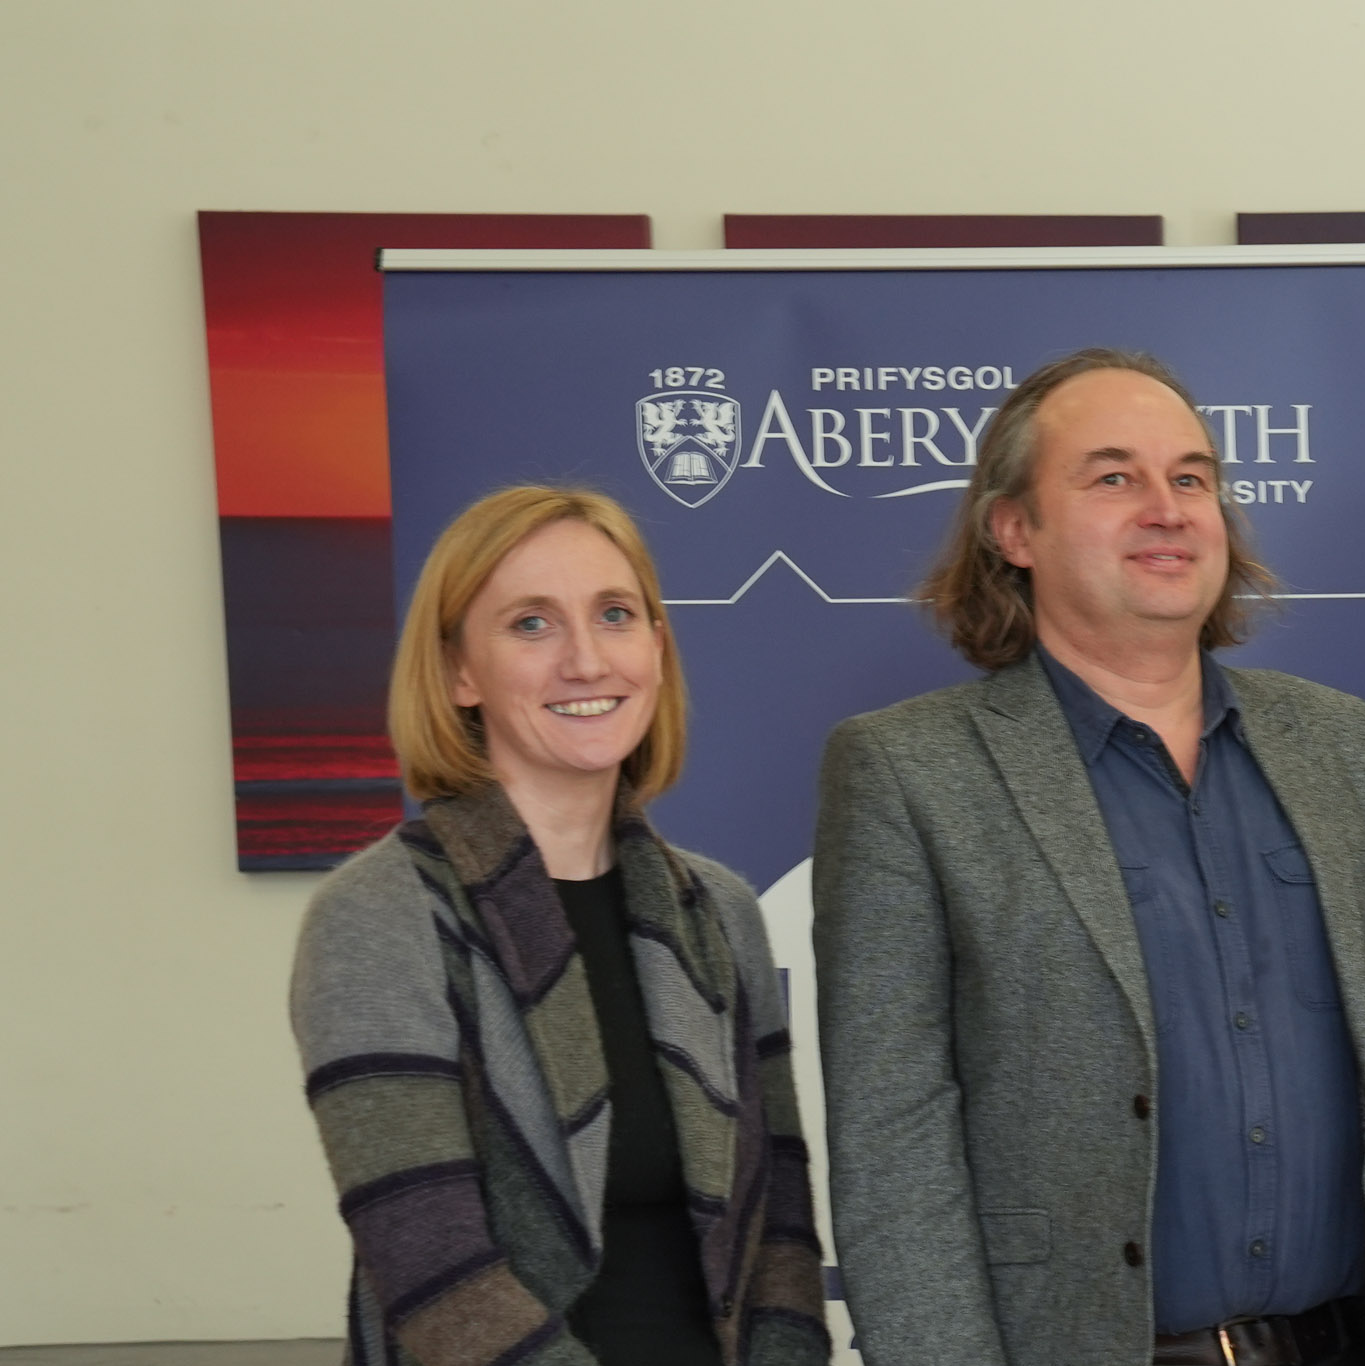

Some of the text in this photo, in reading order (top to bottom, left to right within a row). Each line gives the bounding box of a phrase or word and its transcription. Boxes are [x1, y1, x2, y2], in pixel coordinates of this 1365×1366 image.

[648, 366, 726, 389] 1872
[811, 365, 1020, 391] PRIFYSGOL
[738, 388, 1317, 497] ABERYTH
